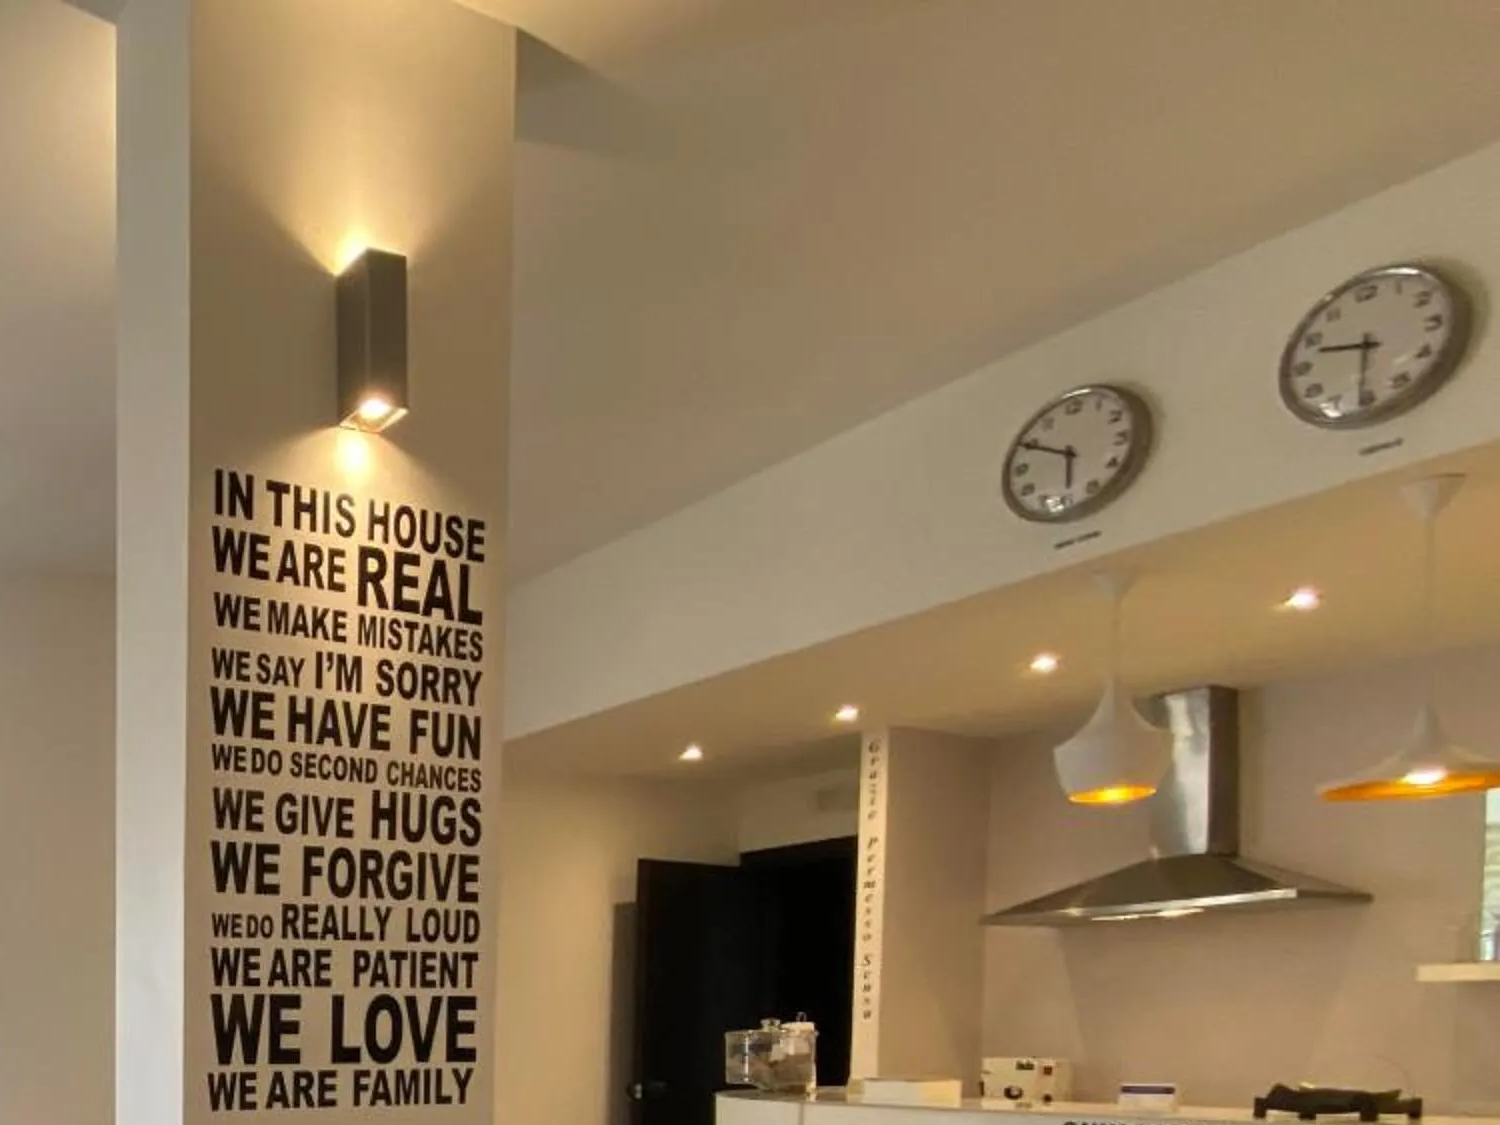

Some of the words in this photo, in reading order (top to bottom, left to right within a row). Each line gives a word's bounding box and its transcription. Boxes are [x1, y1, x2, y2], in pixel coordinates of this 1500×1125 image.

[213, 468, 254, 521] IN
[266, 479, 357, 538] THIS
[368, 499, 486, 562] HOUSE
[211, 525, 271, 581] WE
[276, 539, 347, 592] ARE
[357, 545, 483, 626] REAL
[213, 591, 261, 632] WE
[267, 600, 348, 643] MAKE
[358, 614, 483, 663] MISTAKES
[212, 647, 251, 682] WE
[256, 652, 306, 689] SAY
[315, 651, 363, 693] I'M
[376, 659, 483, 707] SORRY
[210, 686, 276, 741] WE
[288, 695, 391, 751] HAVE
[409, 709, 481, 761] FUN
[211, 744, 247, 772] WE
[252, 748, 283, 776] DO
[289, 752, 378, 784] SECOND
[387, 760, 481, 793] CHANCES
[212, 787, 265, 832] WE
[275, 792, 355, 838] GIVE
[371, 789, 482, 847] HUGS
[211, 840, 281, 896] WE
[302, 846, 480, 903] FORGIVE
[212, 912, 243, 938] WE
[246, 914, 274, 939] DO
[281, 903, 392, 941] REALLY
[406, 908, 481, 943] LOUD
[211, 947, 261, 987] WE
[268, 948, 332, 988] ARE
[353, 950, 479, 989] PATIENT
[210, 994, 301, 1065] WE
[331, 994, 477, 1064] LOVE
[208, 1071, 258, 1112] WE
[266, 1070, 338, 1109] ARE
[353, 1068, 474, 1108] FAMILY
